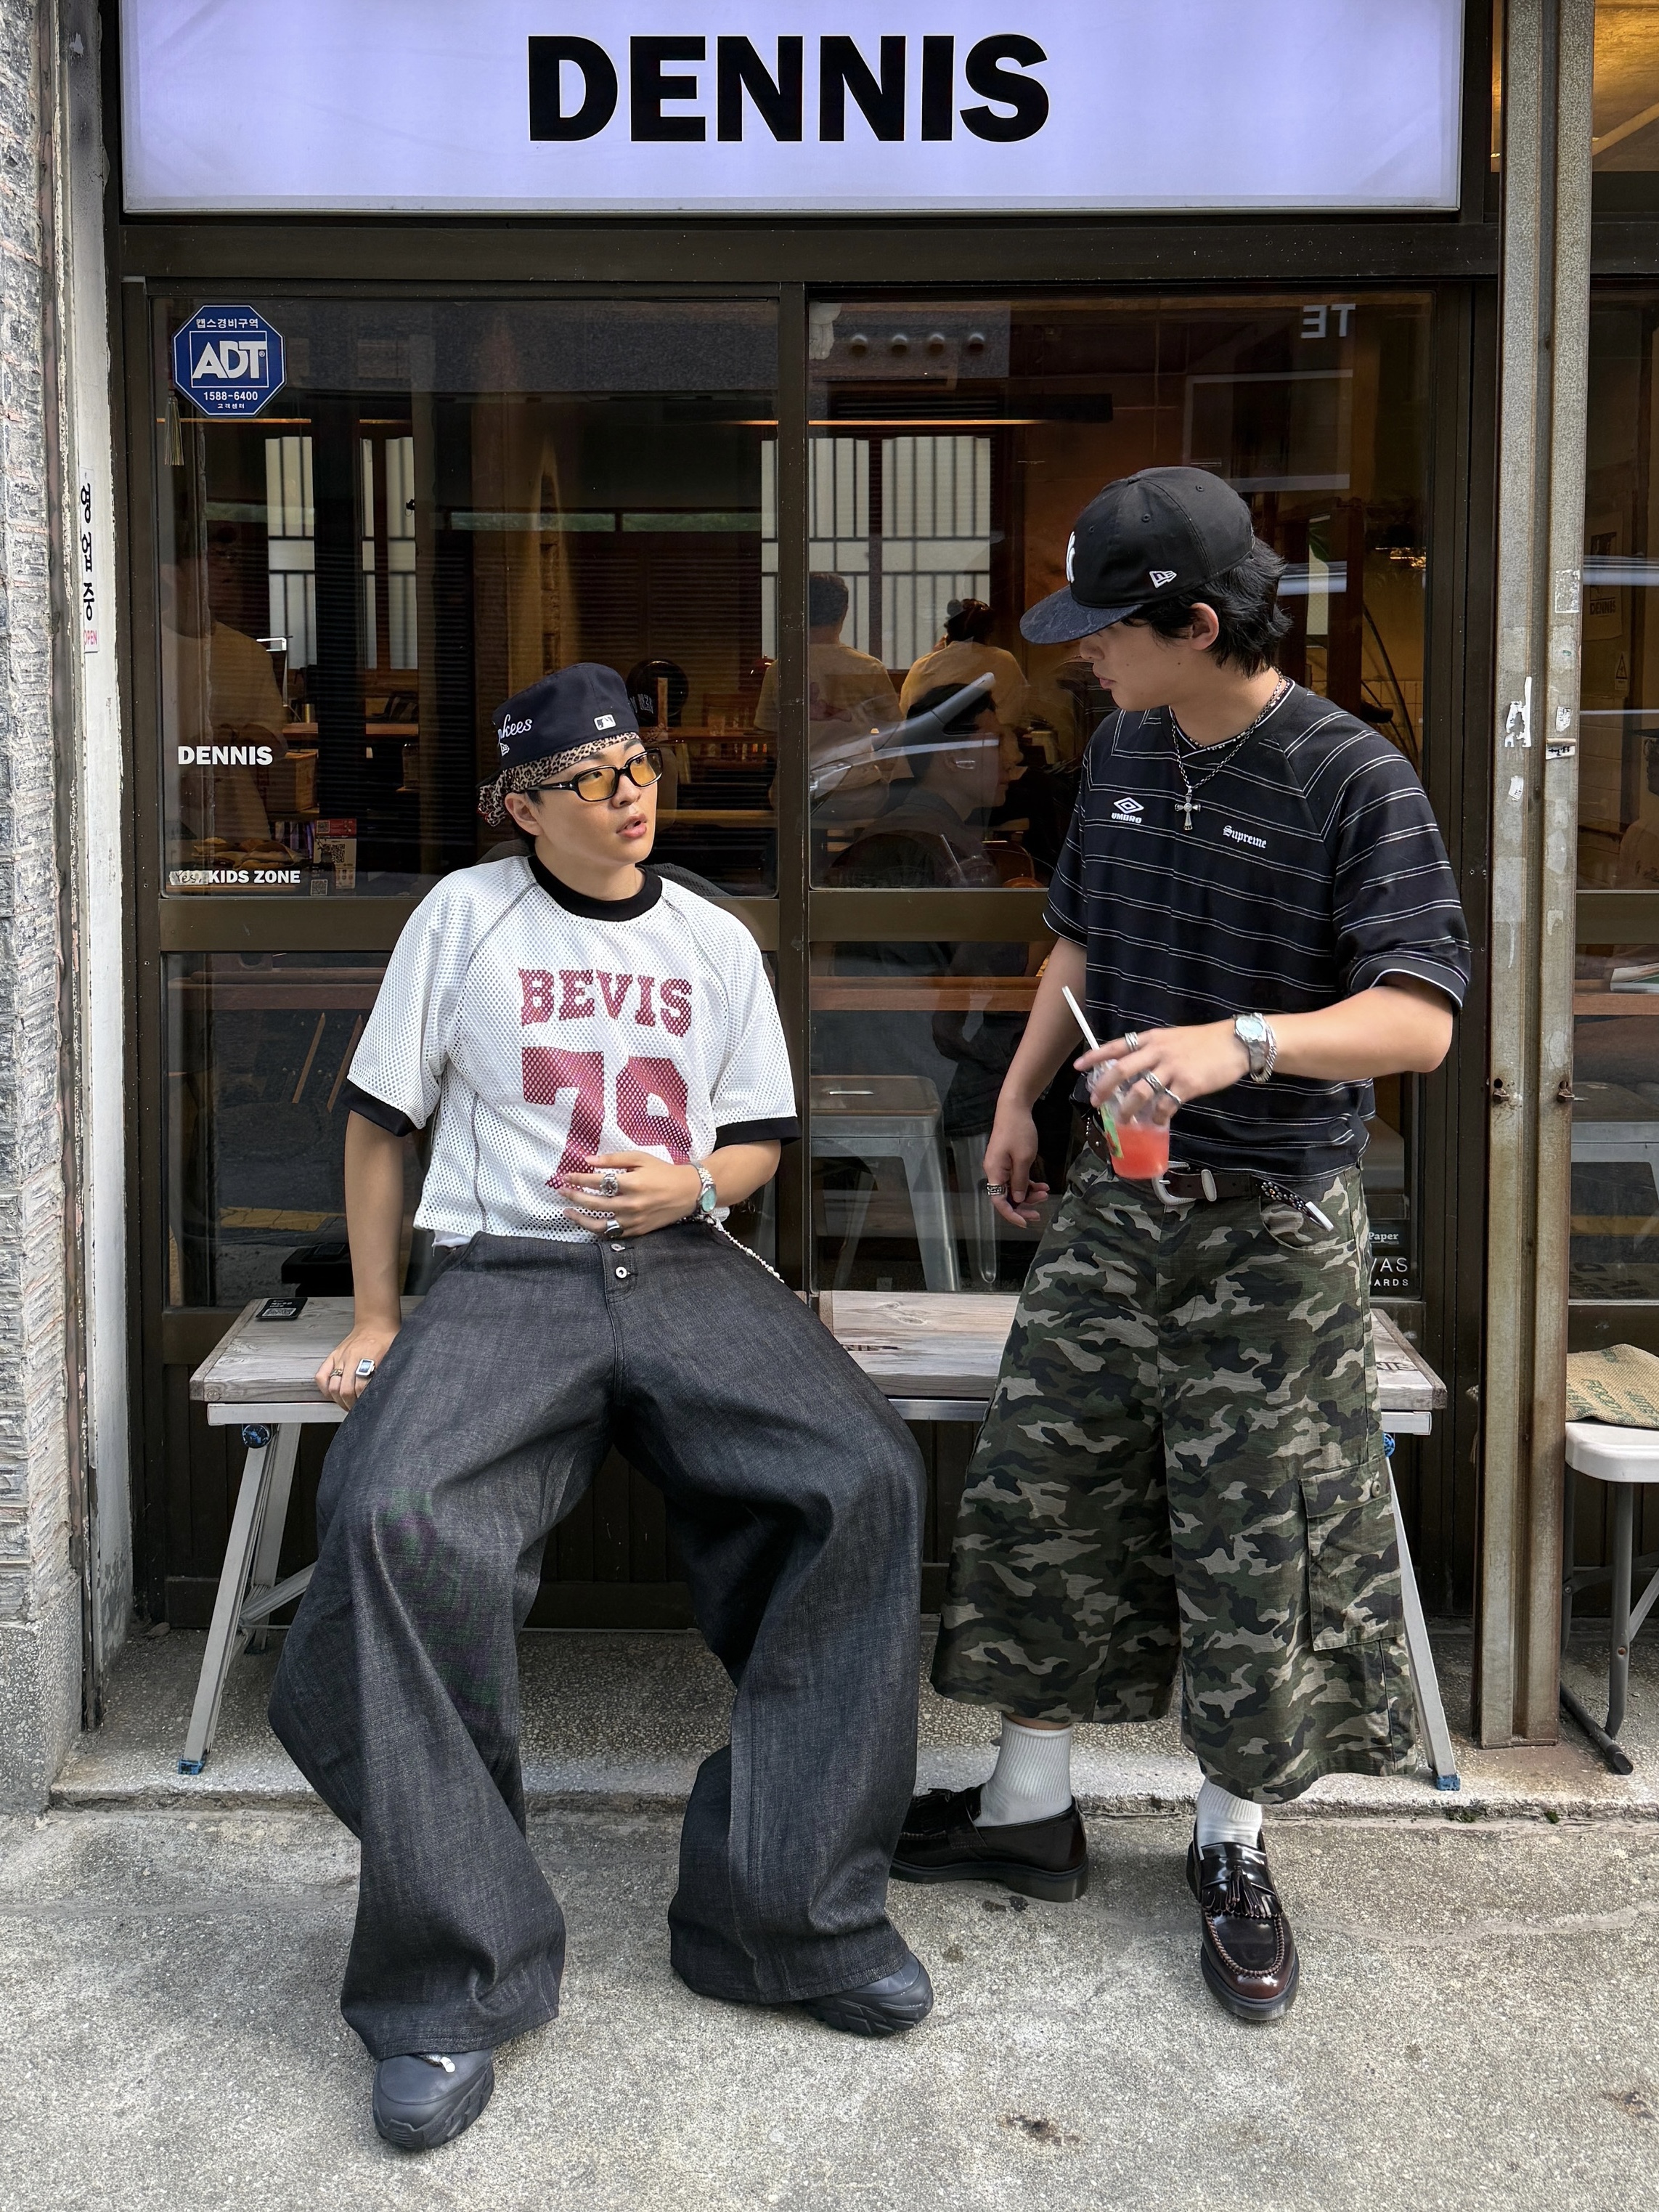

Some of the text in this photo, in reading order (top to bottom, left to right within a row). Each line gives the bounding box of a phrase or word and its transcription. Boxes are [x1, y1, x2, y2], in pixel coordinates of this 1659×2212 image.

[528, 33, 1049, 142] DENNIS
[196, 318, 258, 328] 캡스경비구역
[192, 341, 267, 378] ADT
[203, 391, 258, 401] 1588-6400
[83, 630, 97, 645] OPEN
[178, 746, 273, 765] DENNIS
[1223, 825, 1267, 848] Supreme
[209, 870, 250, 883] KIDS
[253, 870, 301, 883] ZONE
[518, 967, 693, 1038] BEVIS
[521, 1046, 693, 1190] 79
[1368, 1232, 1399, 1242] Paper
